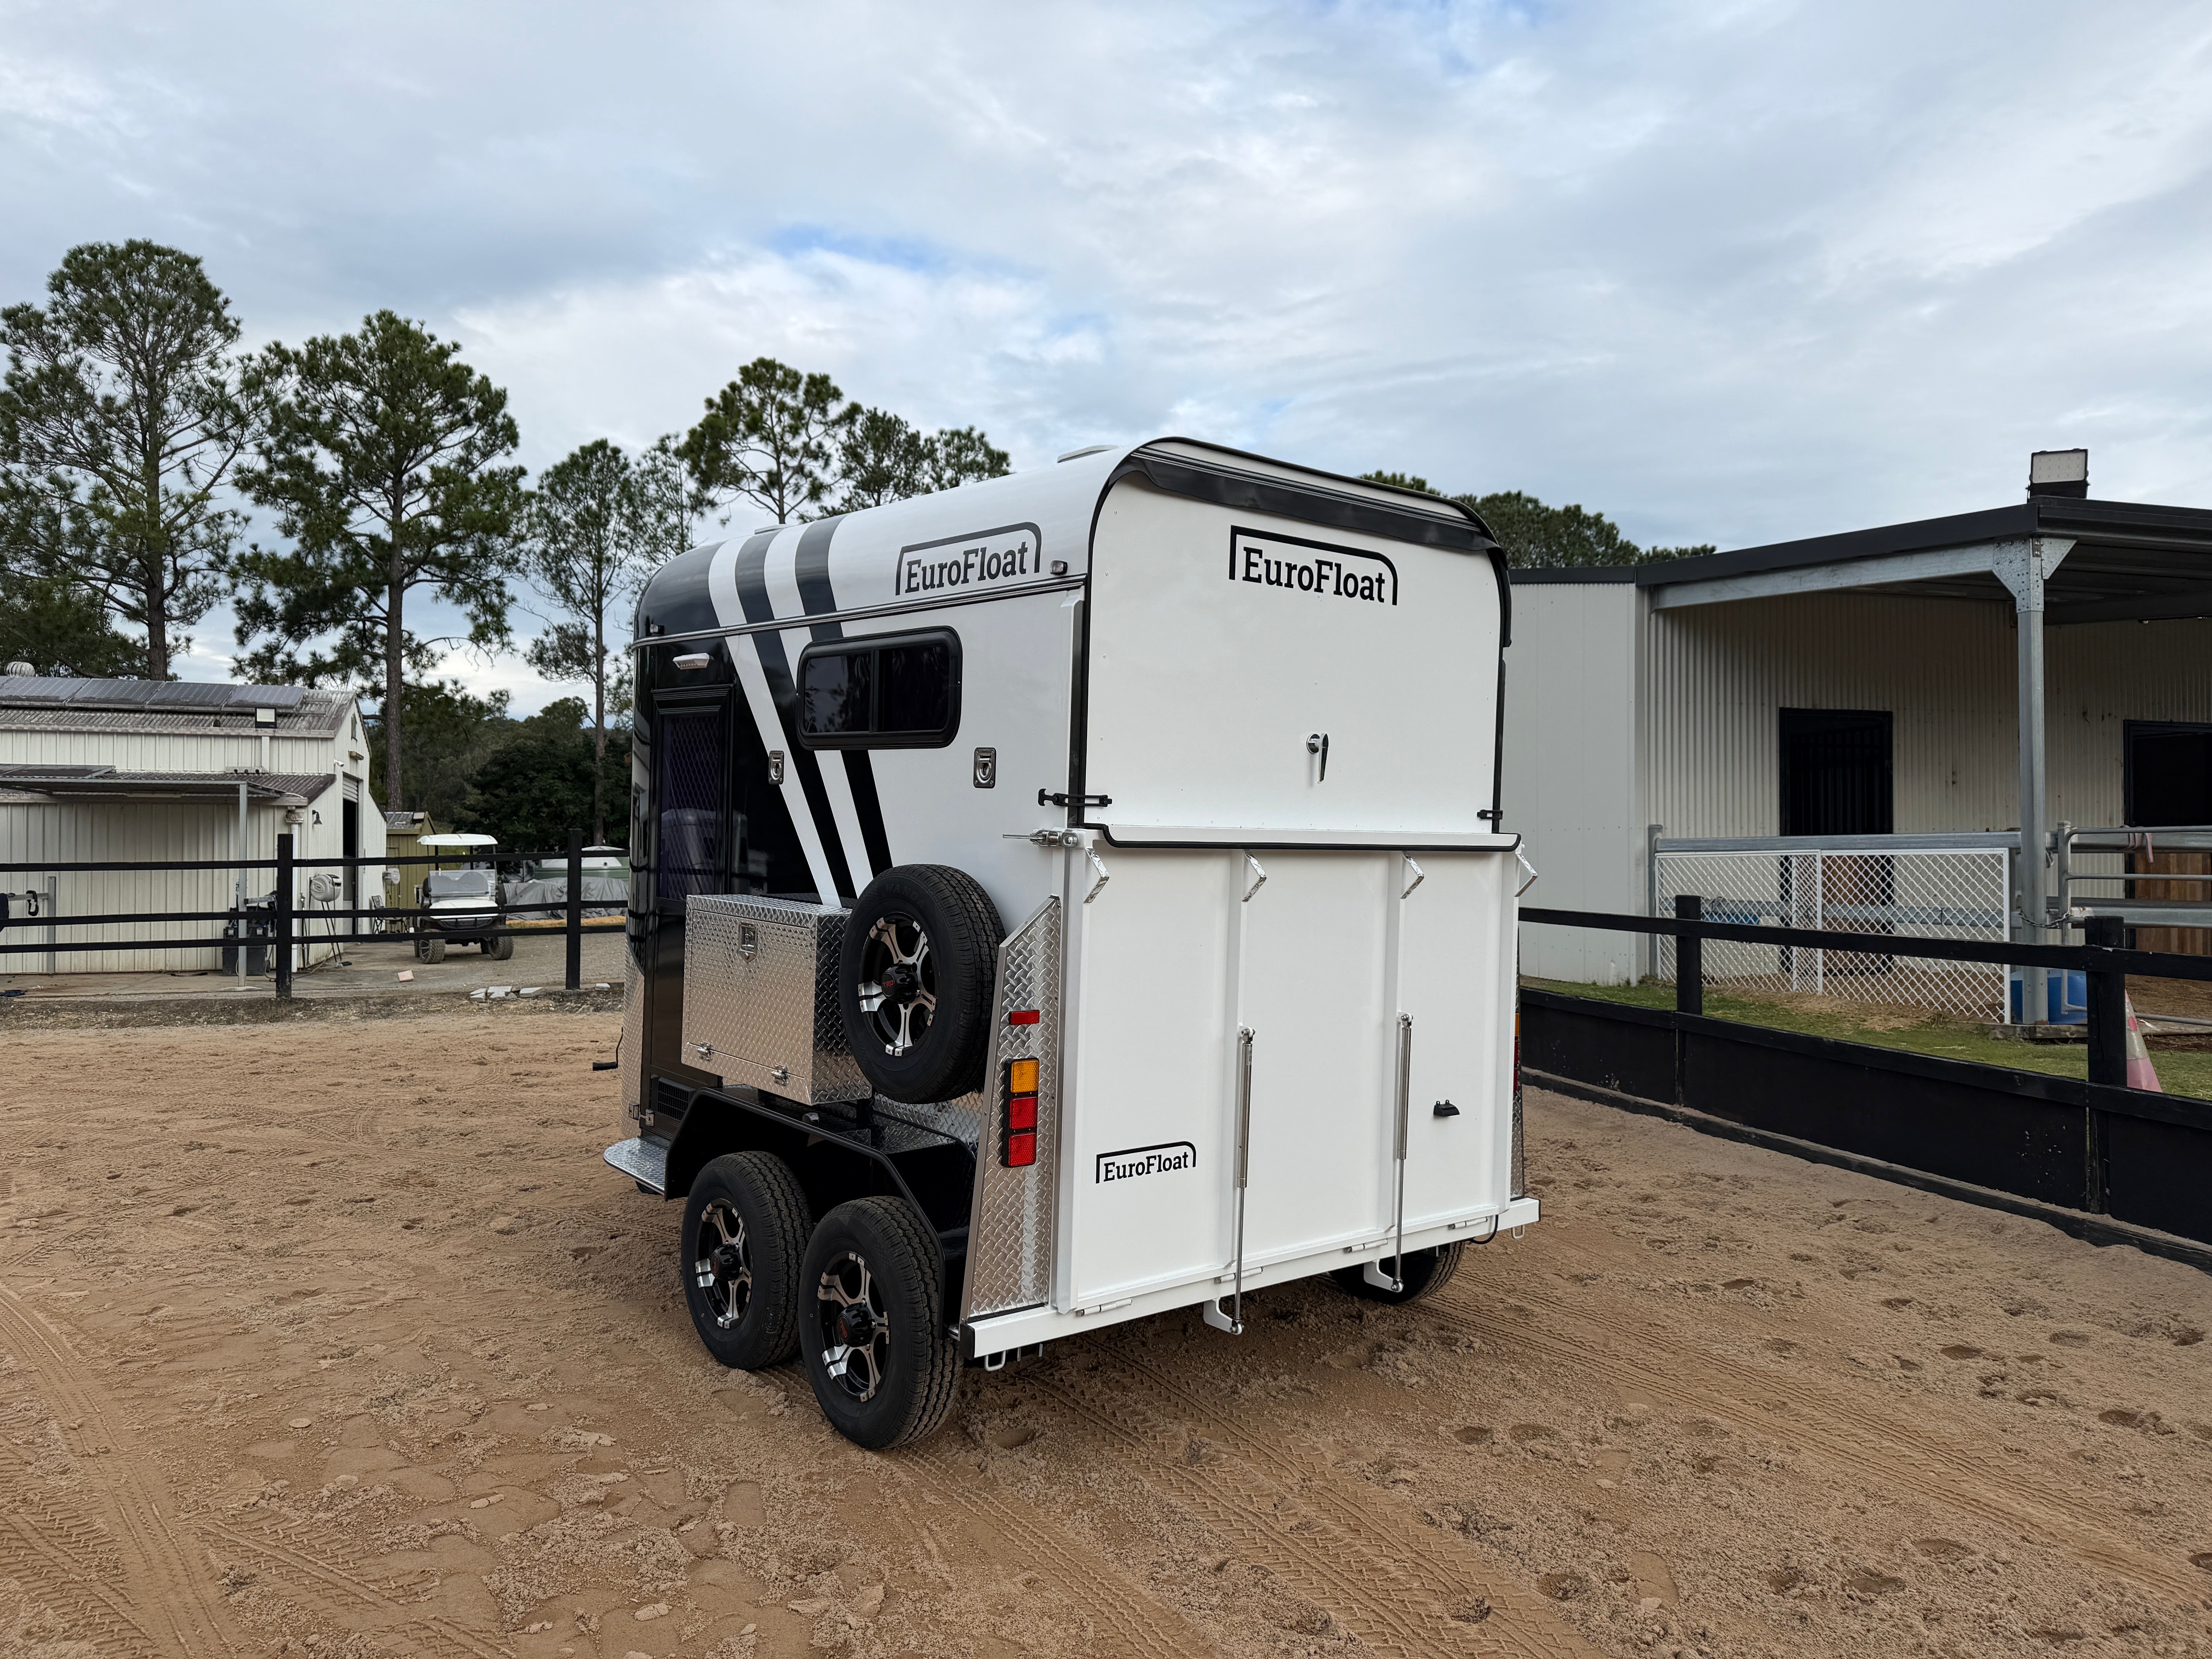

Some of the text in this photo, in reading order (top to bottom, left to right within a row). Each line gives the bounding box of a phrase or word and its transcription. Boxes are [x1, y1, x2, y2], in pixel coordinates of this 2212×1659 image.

[905, 541, 1028, 593] EuroFloat
[1242, 546, 1385, 603] EuroFloat
[1103, 1151, 1188, 1182] EuroFloat
